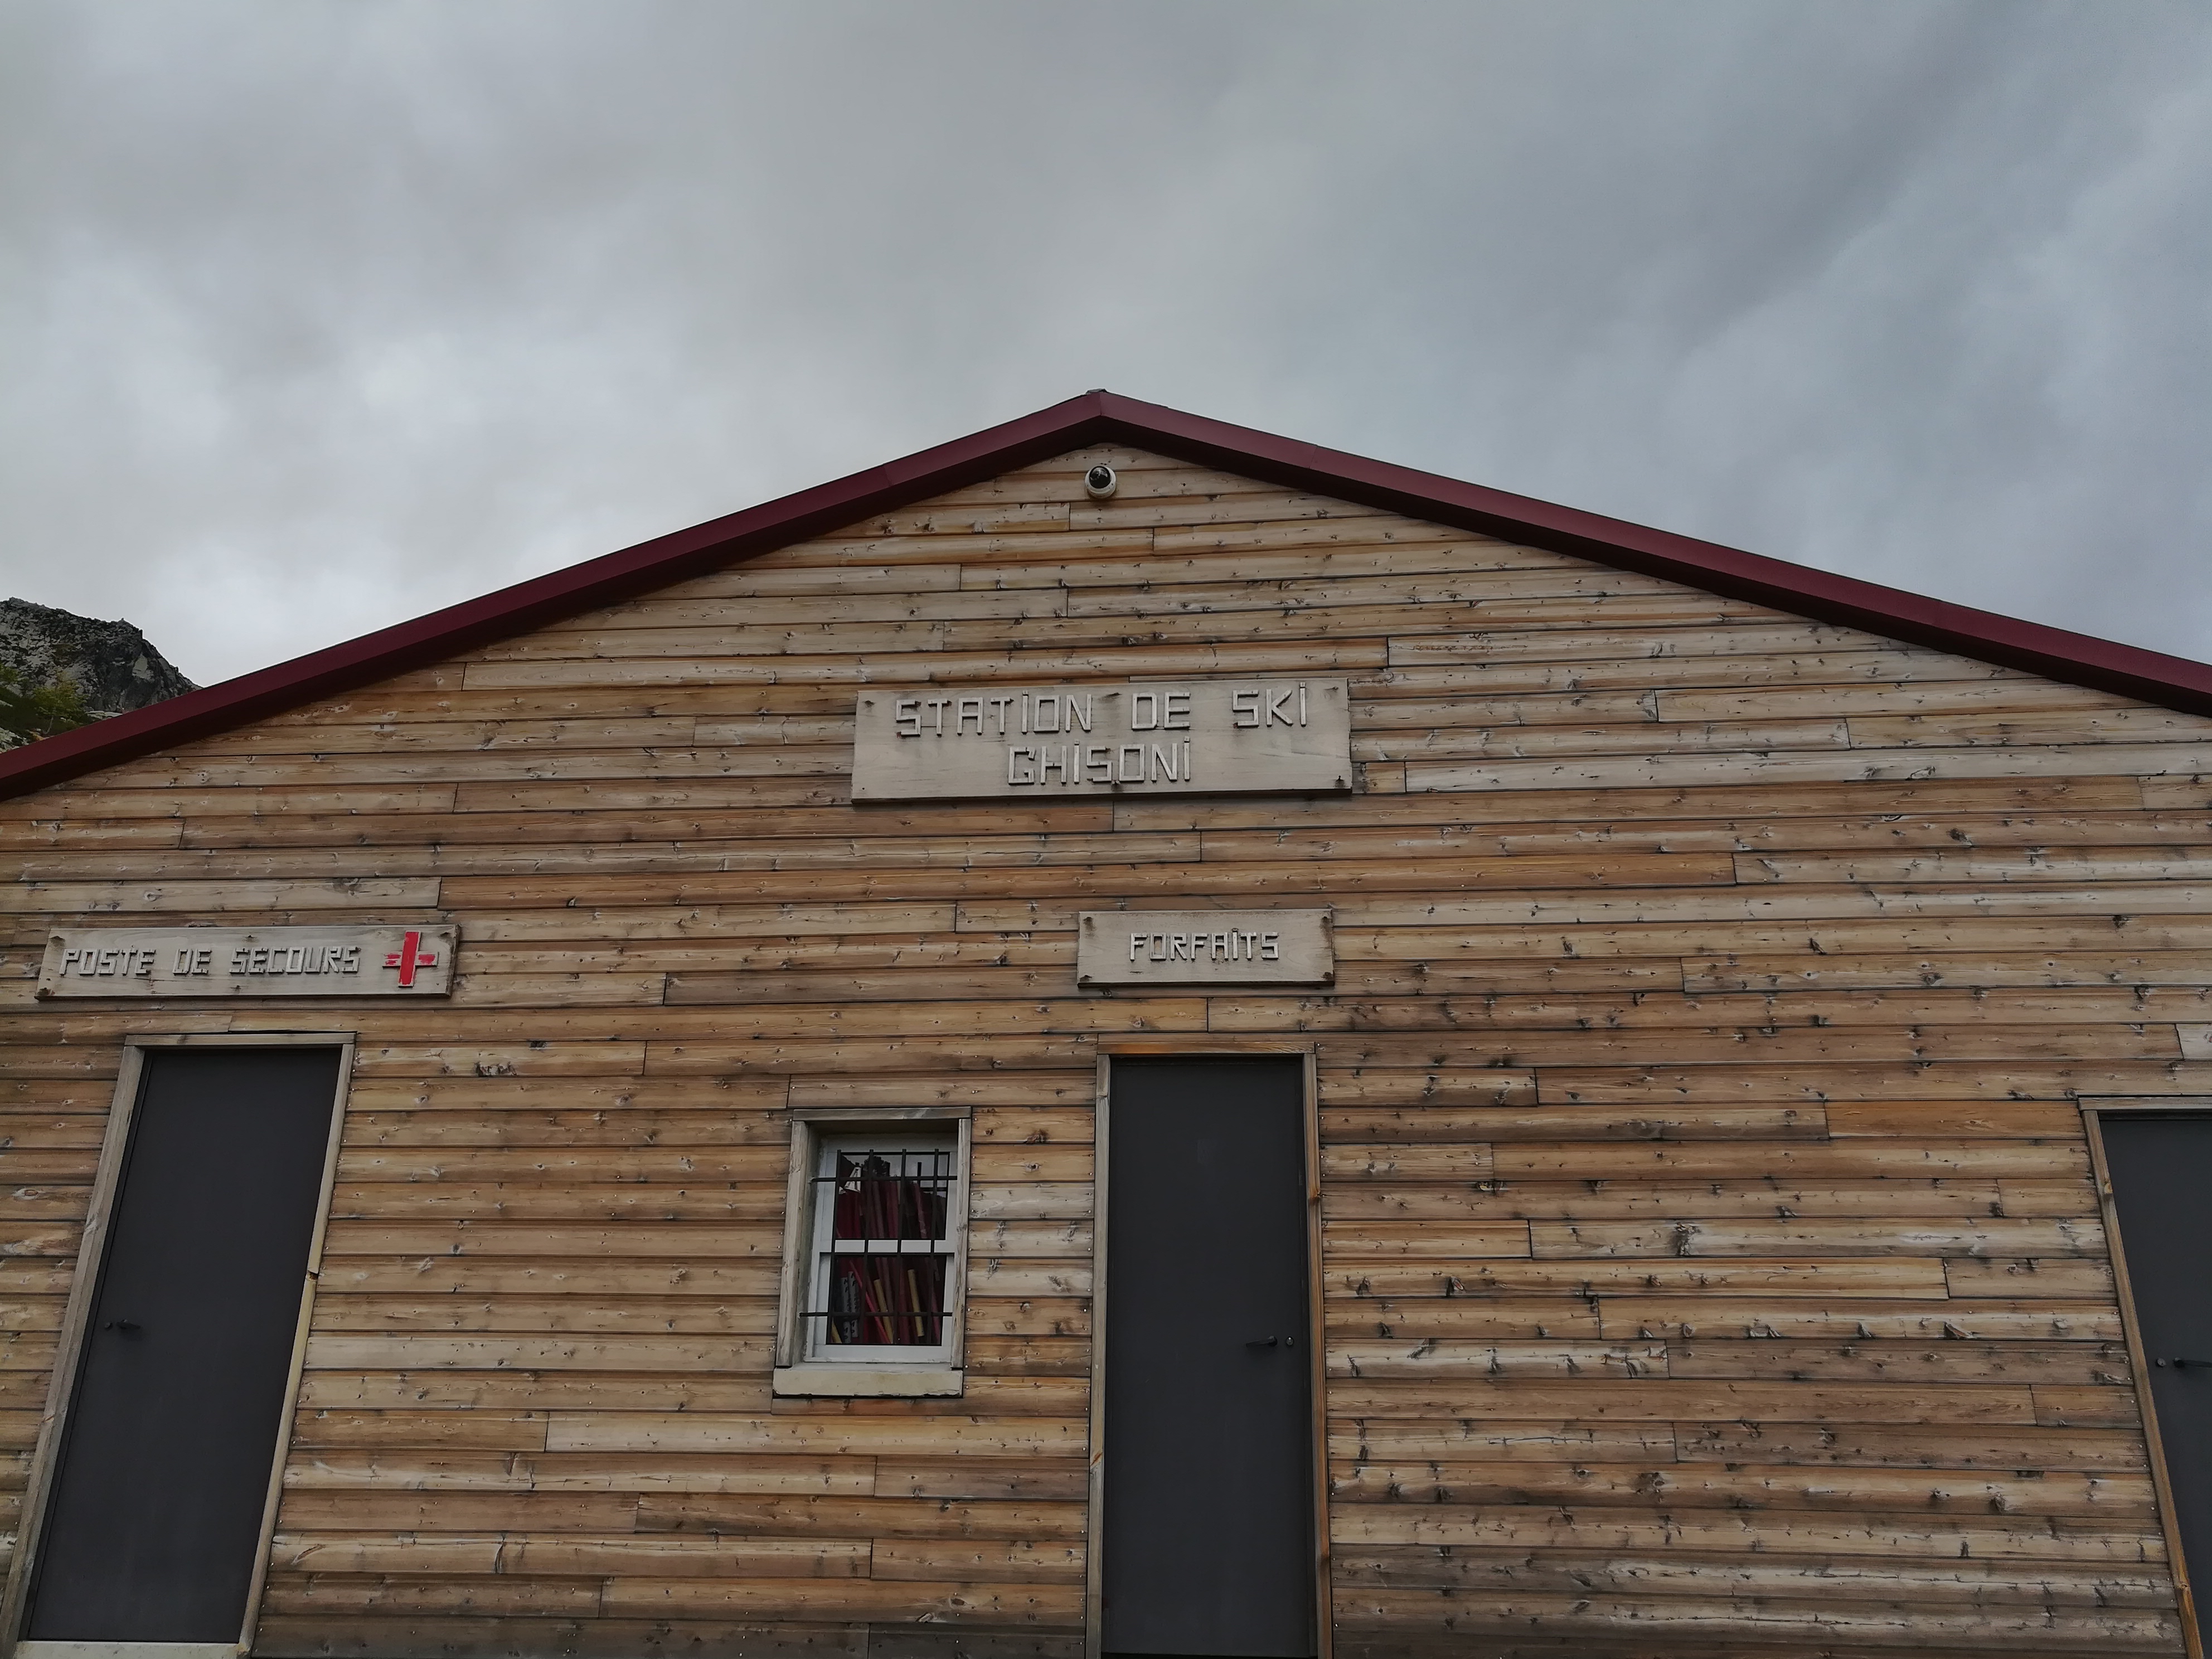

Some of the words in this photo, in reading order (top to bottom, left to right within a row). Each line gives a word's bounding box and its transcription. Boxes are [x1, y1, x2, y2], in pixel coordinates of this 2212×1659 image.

[896, 690, 1092, 737] STATION
[1131, 691, 1191, 731] DE
[1231, 682, 1307, 728] SKI
[59, 948, 156, 976] POSTE
[172, 948, 211, 974] DE
[230, 946, 360, 974] SECOURS
